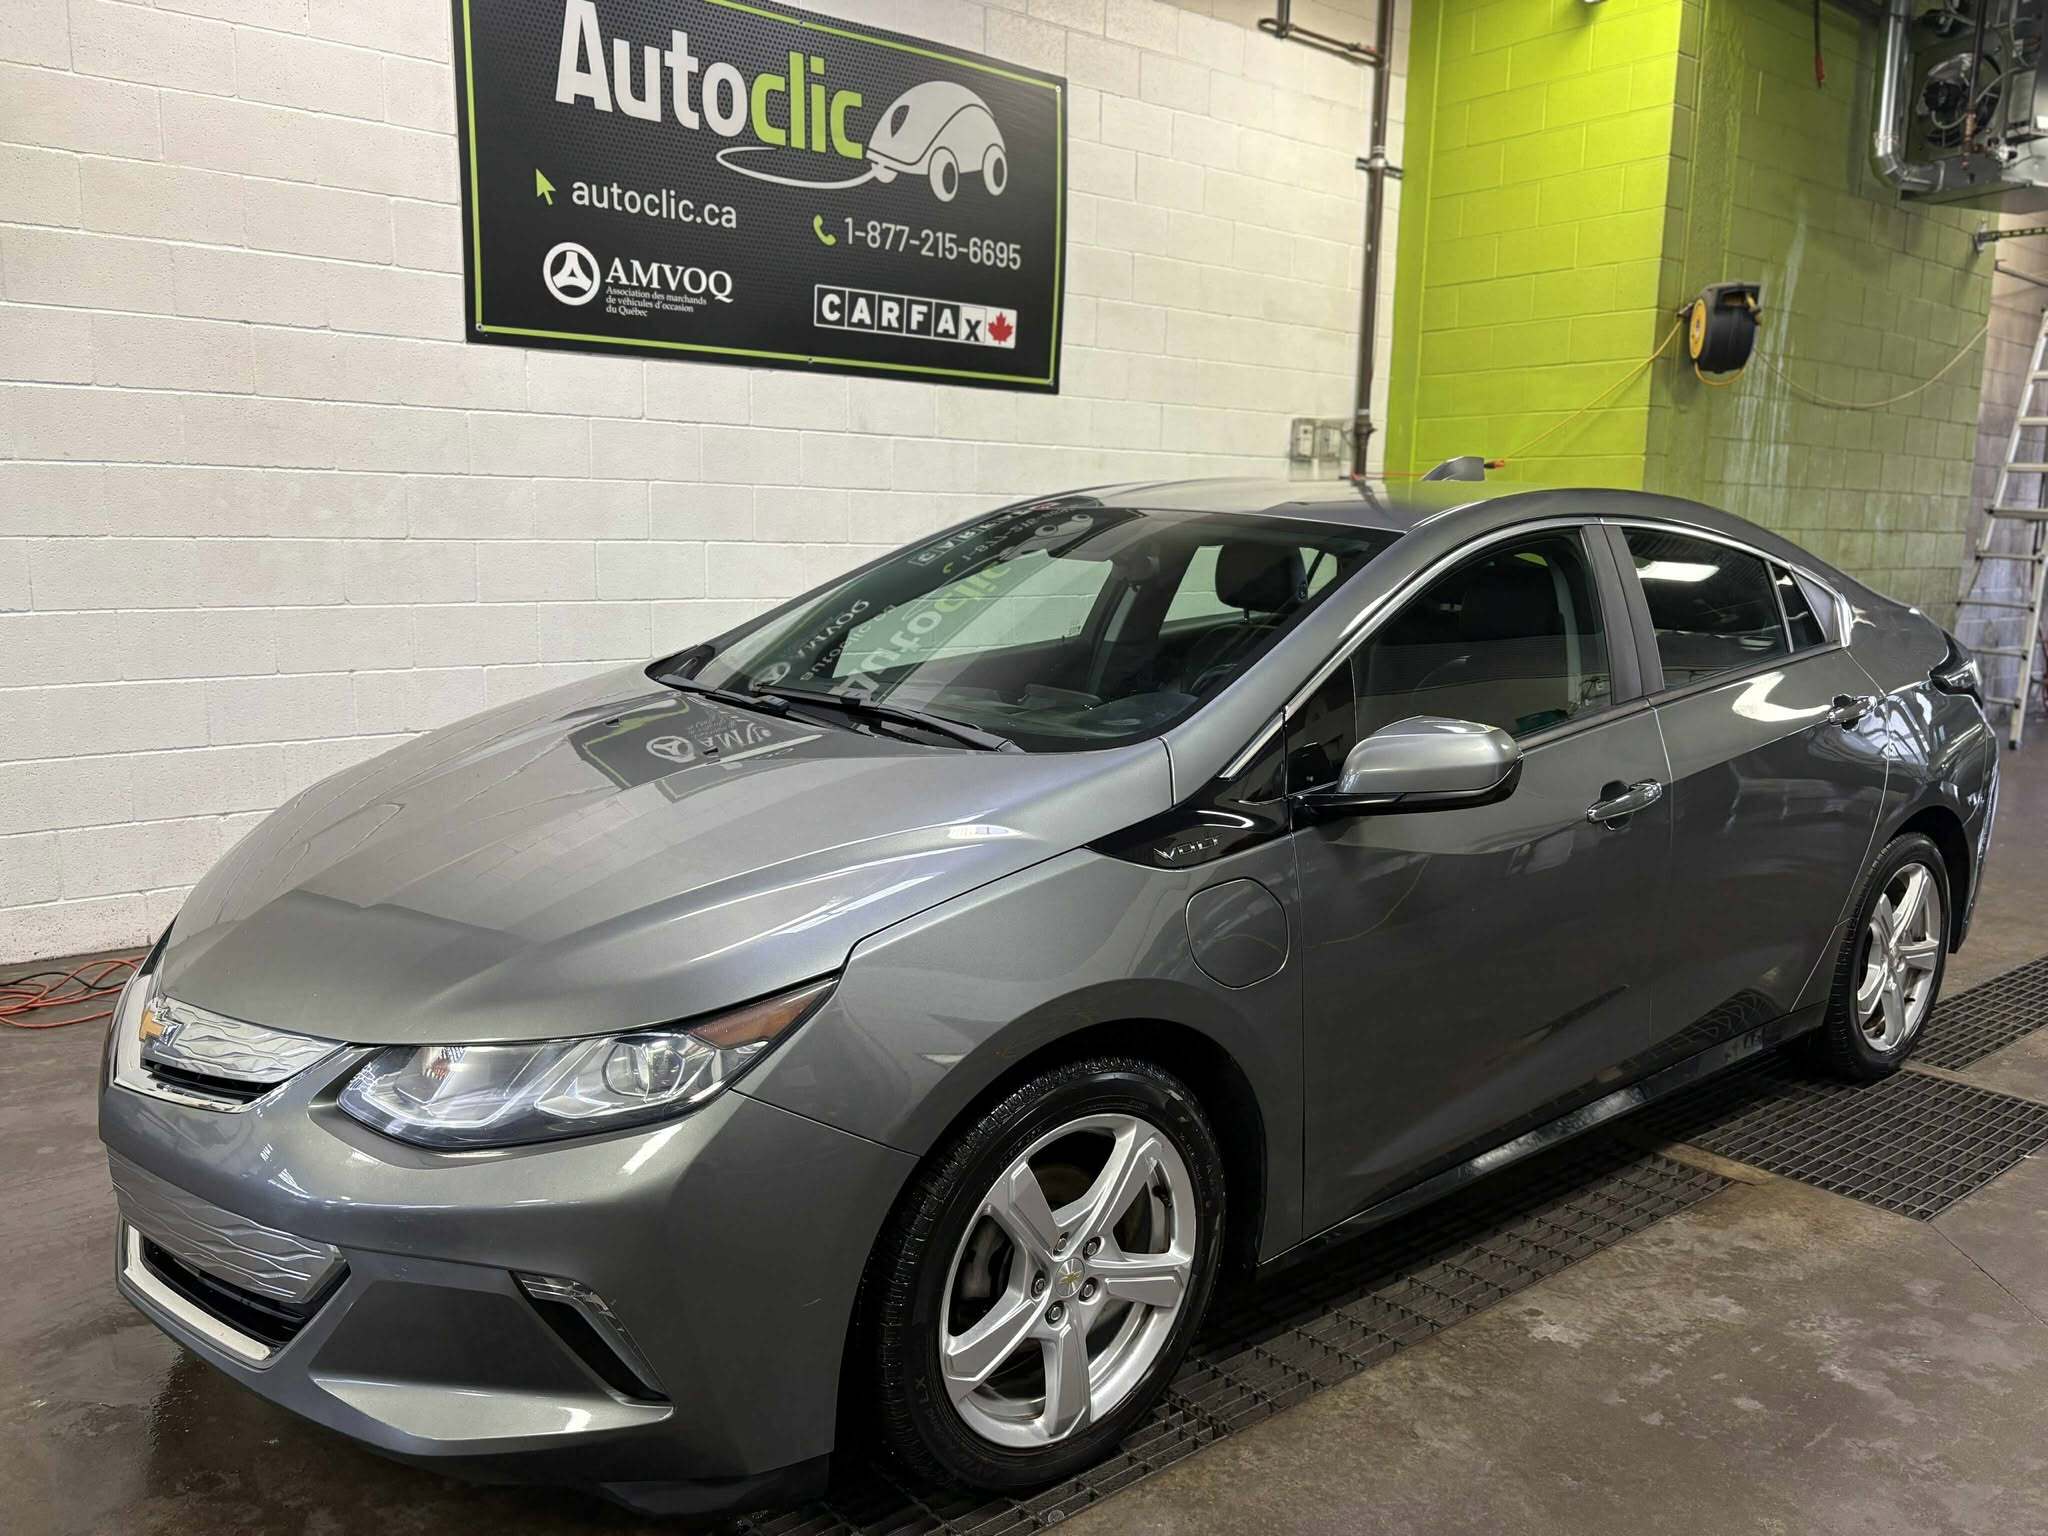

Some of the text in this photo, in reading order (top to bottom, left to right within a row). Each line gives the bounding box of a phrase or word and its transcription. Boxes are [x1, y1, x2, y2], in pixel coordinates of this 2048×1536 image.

[555, 0, 863, 160] Autoclic
[571, 181, 737, 229] autoclic.ca
[844, 216, 1022, 271] 1-877-215-6695
[605, 256, 734, 304] AMVOQ
[606, 286, 708, 305] Association des marchands
[606, 296, 694, 312] de véhicules d'occasion
[618, 306, 648, 318] Québec
[820, 292, 986, 342] CARFAX
